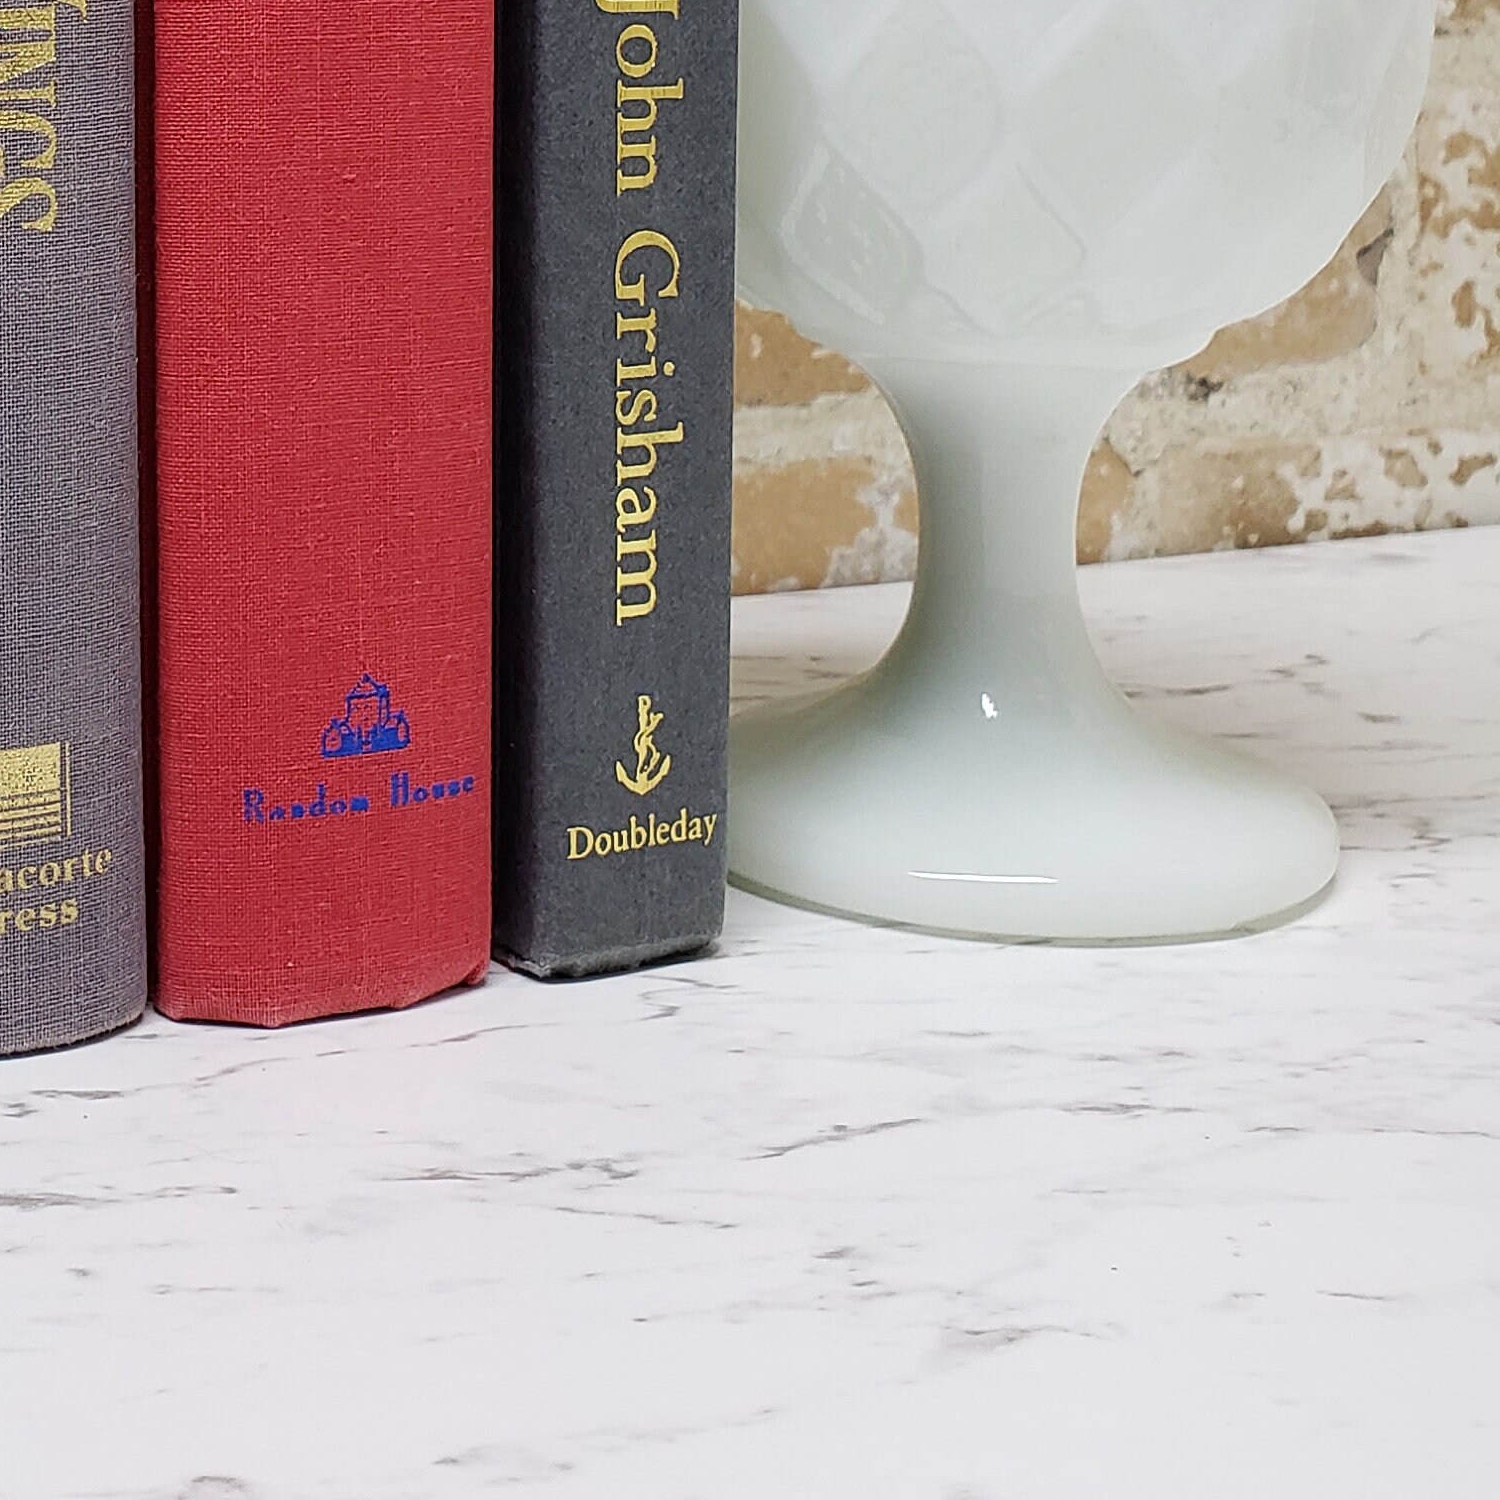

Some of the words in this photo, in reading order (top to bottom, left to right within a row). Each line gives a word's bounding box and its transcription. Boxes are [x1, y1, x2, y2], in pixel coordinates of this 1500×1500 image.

[613, 228, 685, 627] Grisham
[242, 788, 370, 825] Random
[388, 771, 477, 810] House
[566, 808, 718, 863] Doubleday
